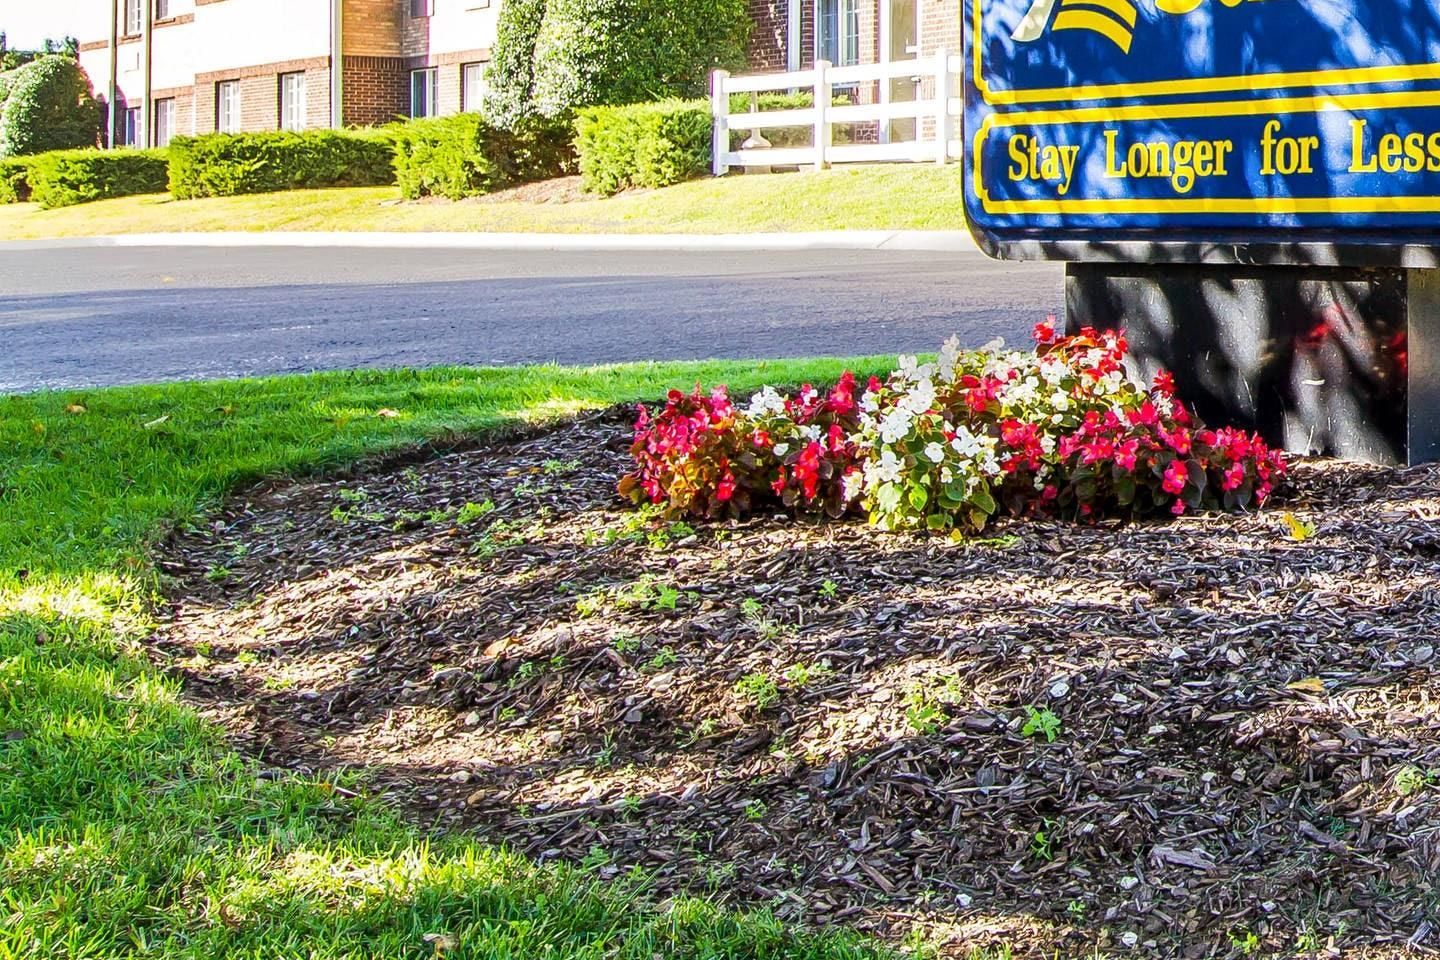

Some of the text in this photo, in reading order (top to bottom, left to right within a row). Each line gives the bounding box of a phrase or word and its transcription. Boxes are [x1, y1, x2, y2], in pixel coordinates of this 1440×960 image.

[1007, 134, 1079, 195] Stay
[1104, 129, 1232, 193] Longer
[1260, 120, 1318, 175] for
